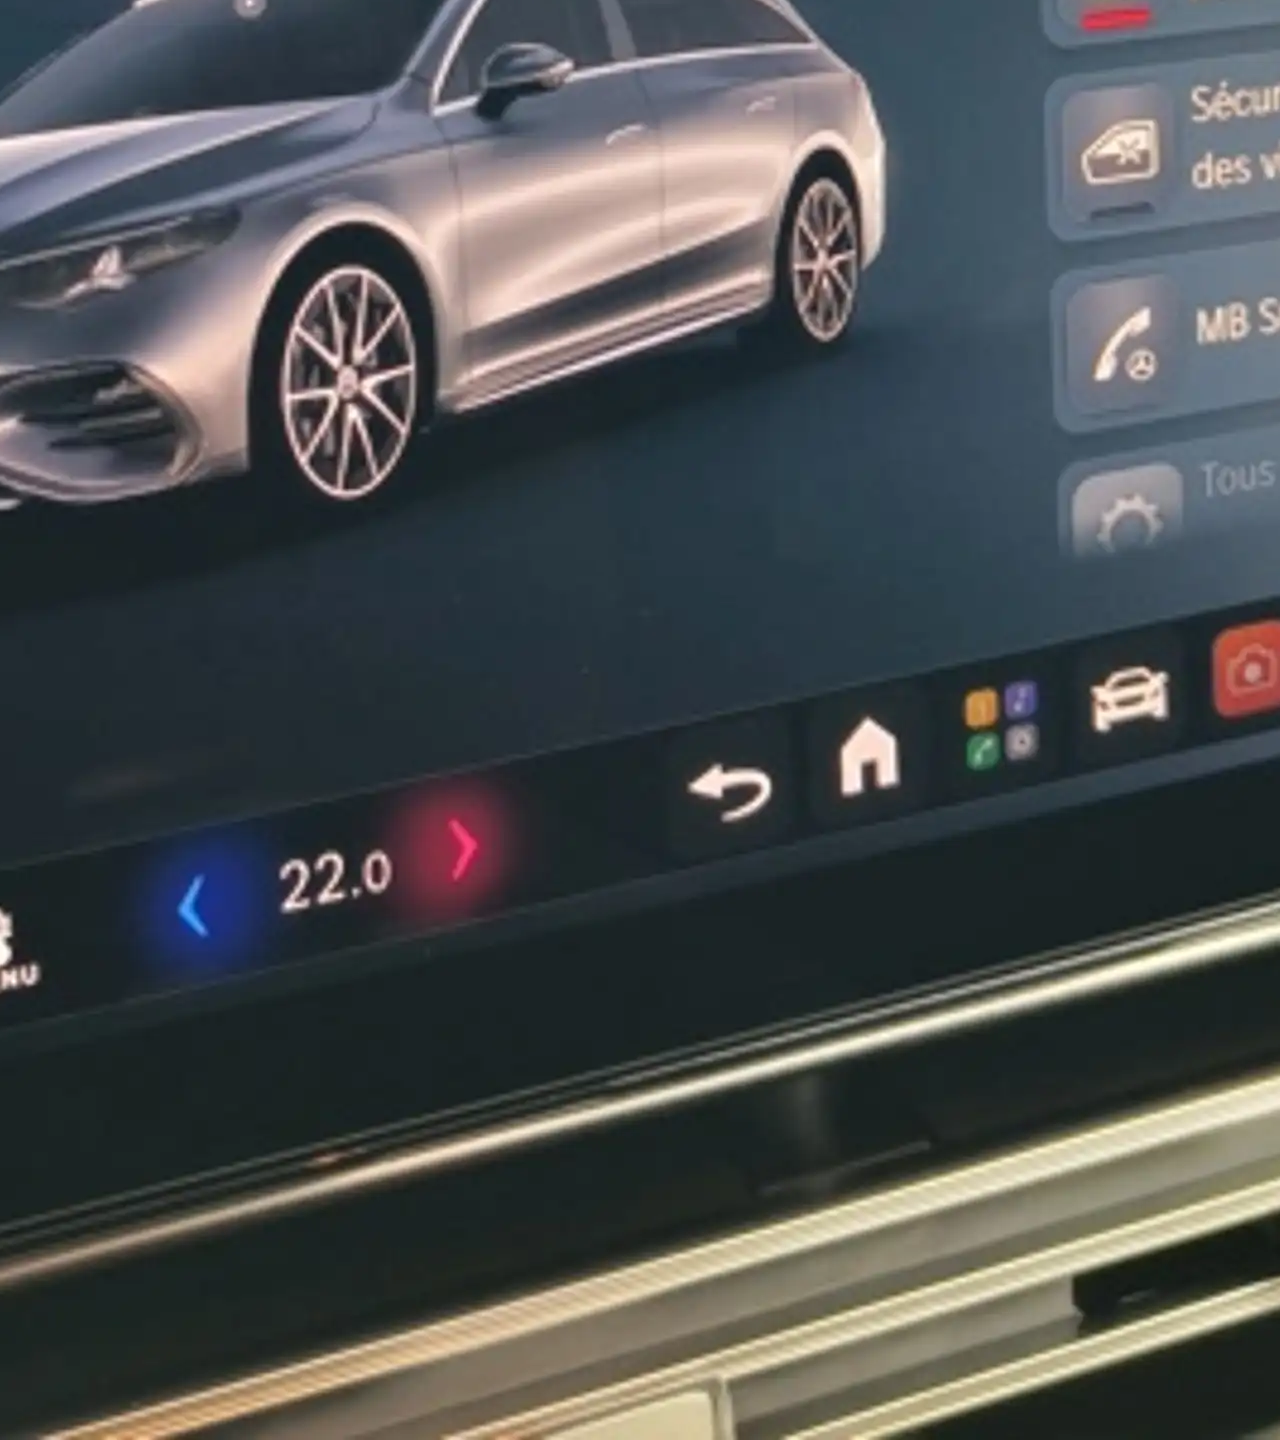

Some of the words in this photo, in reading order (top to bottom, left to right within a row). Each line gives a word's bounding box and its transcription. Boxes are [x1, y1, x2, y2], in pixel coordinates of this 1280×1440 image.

[1192, 149, 1252, 192] des
[1196, 302, 1250, 347] MB
[1202, 458, 1276, 497] Tous
[278, 849, 393, 914] 22.0
